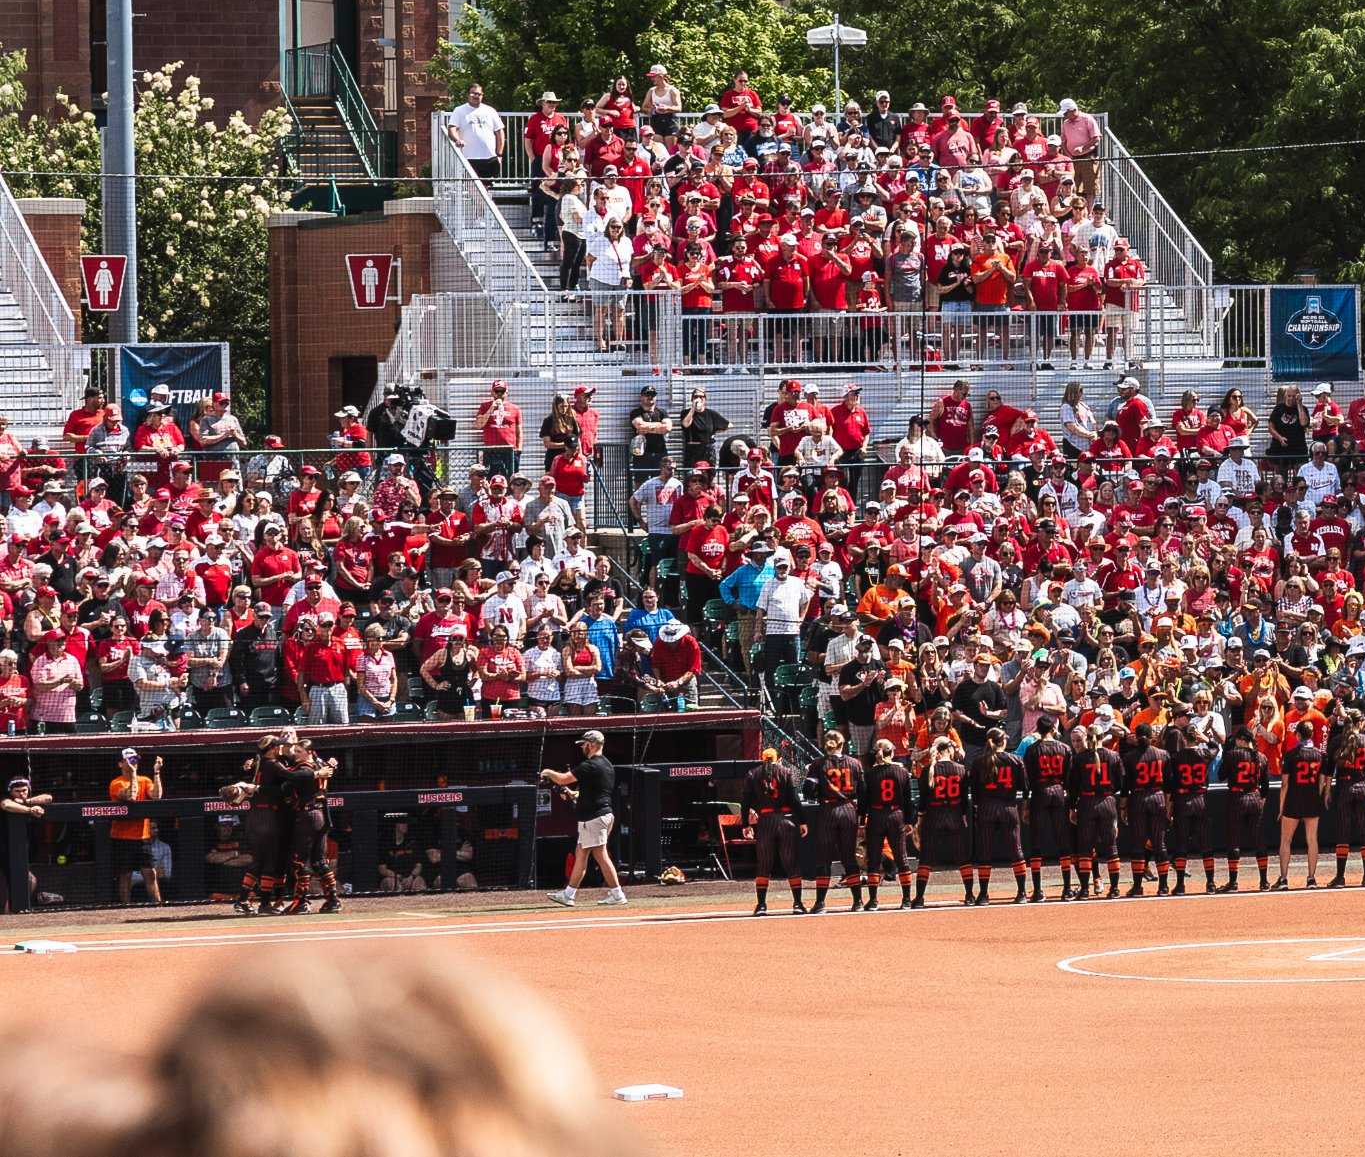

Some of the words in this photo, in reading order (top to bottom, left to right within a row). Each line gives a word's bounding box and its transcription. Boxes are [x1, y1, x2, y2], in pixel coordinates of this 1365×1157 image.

[1288, 324, 1340, 332] CHAMPIONSHIP
[499, 608, 513, 623] N
[669, 766, 713, 777] HUSKERS
[826, 768, 854, 793] 31
[984, 766, 1013, 789] 4
[1135, 759, 1163, 784] 34
[1178, 763, 1206, 786] 33
[418, 792, 463, 804] HUSKERS
[881, 779, 895, 801] 8
[934, 775, 961, 799] 26
[81, 805, 129, 817] HUSKERS
